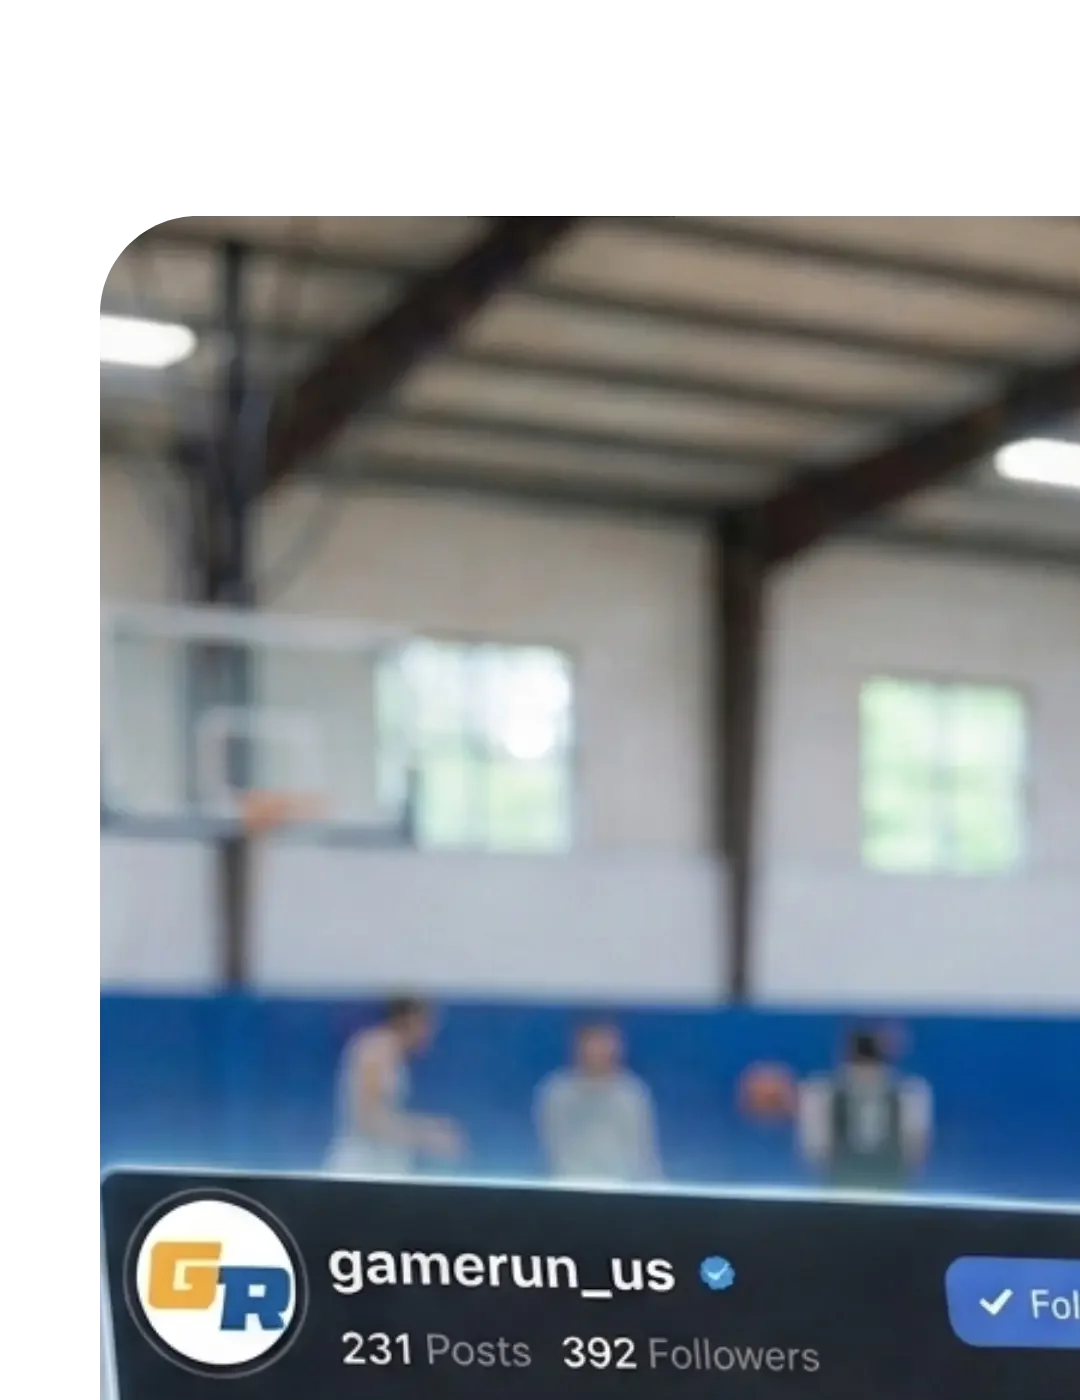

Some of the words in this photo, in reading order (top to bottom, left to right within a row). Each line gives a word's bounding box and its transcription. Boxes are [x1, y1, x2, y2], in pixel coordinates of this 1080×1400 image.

[147, 1240, 291, 1332] GR
[328, 1249, 676, 1299] gamerun_us
[342, 1331, 411, 1365] 231
[426, 1333, 532, 1368] Posts
[562, 1335, 637, 1370] 392
[649, 1337, 820, 1373] Followers
